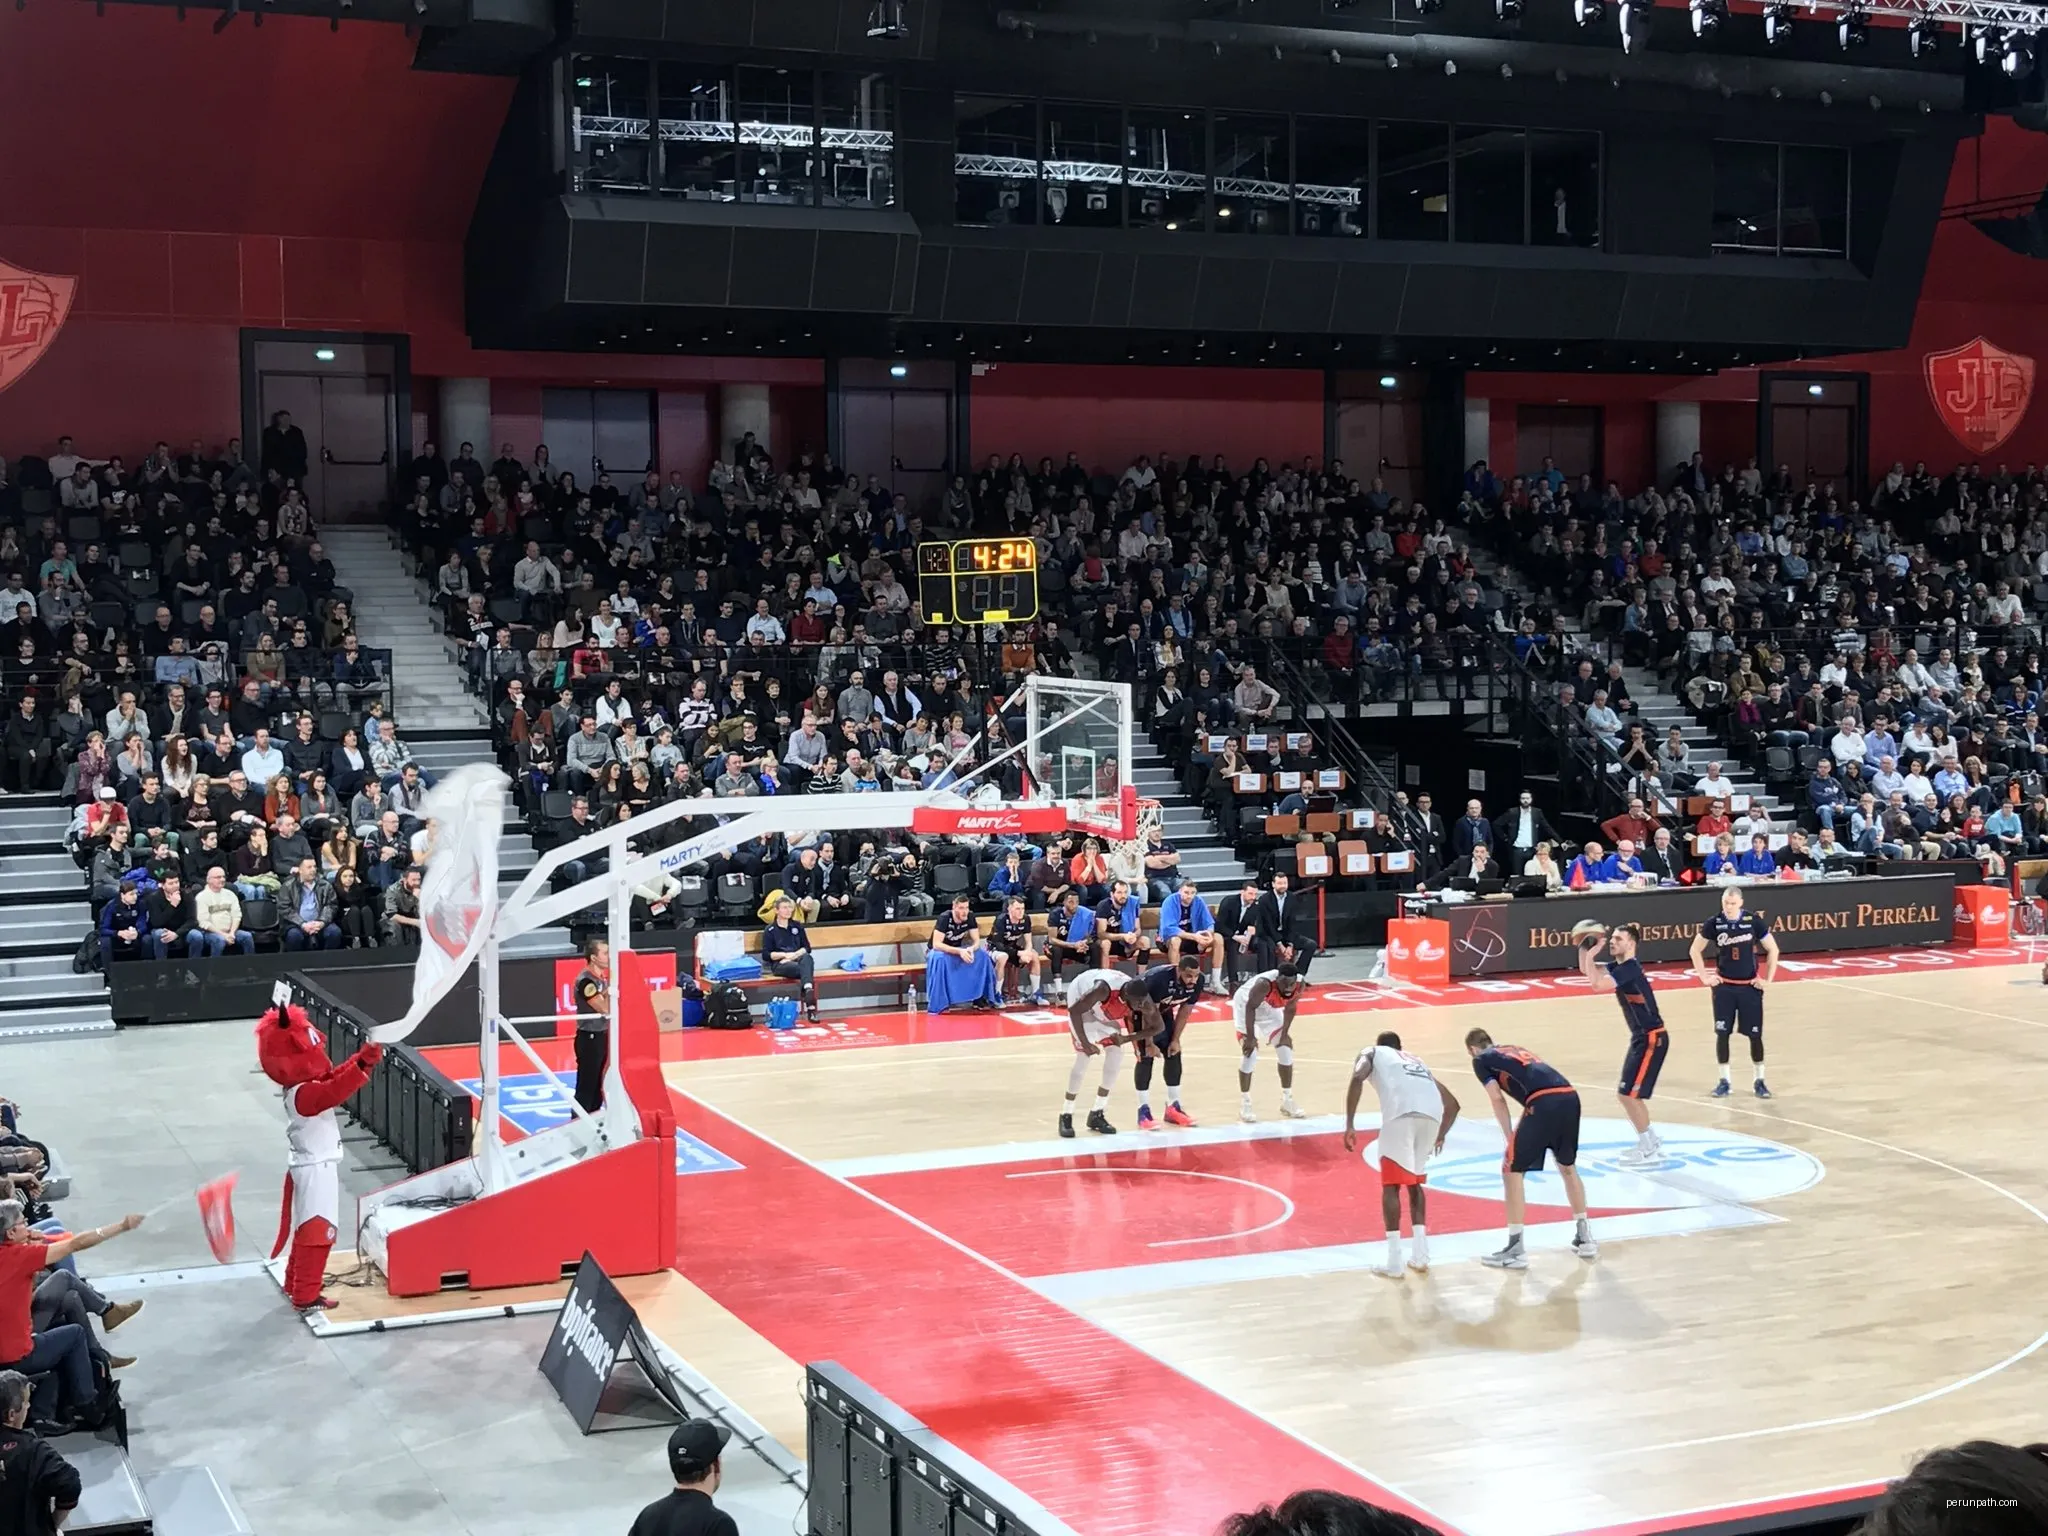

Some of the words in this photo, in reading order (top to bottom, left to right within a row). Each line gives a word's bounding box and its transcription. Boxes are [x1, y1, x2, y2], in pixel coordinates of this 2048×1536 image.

[974, 544, 1031, 569] 4:24
[957, 816, 1001, 829] MARTY
[660, 844, 702, 870] MARTY
[1529, 927, 1572, 949] HÔT
[1756, 911, 1850, 933] AURENT
[1857, 902, 1940, 927] PERRÉAL
